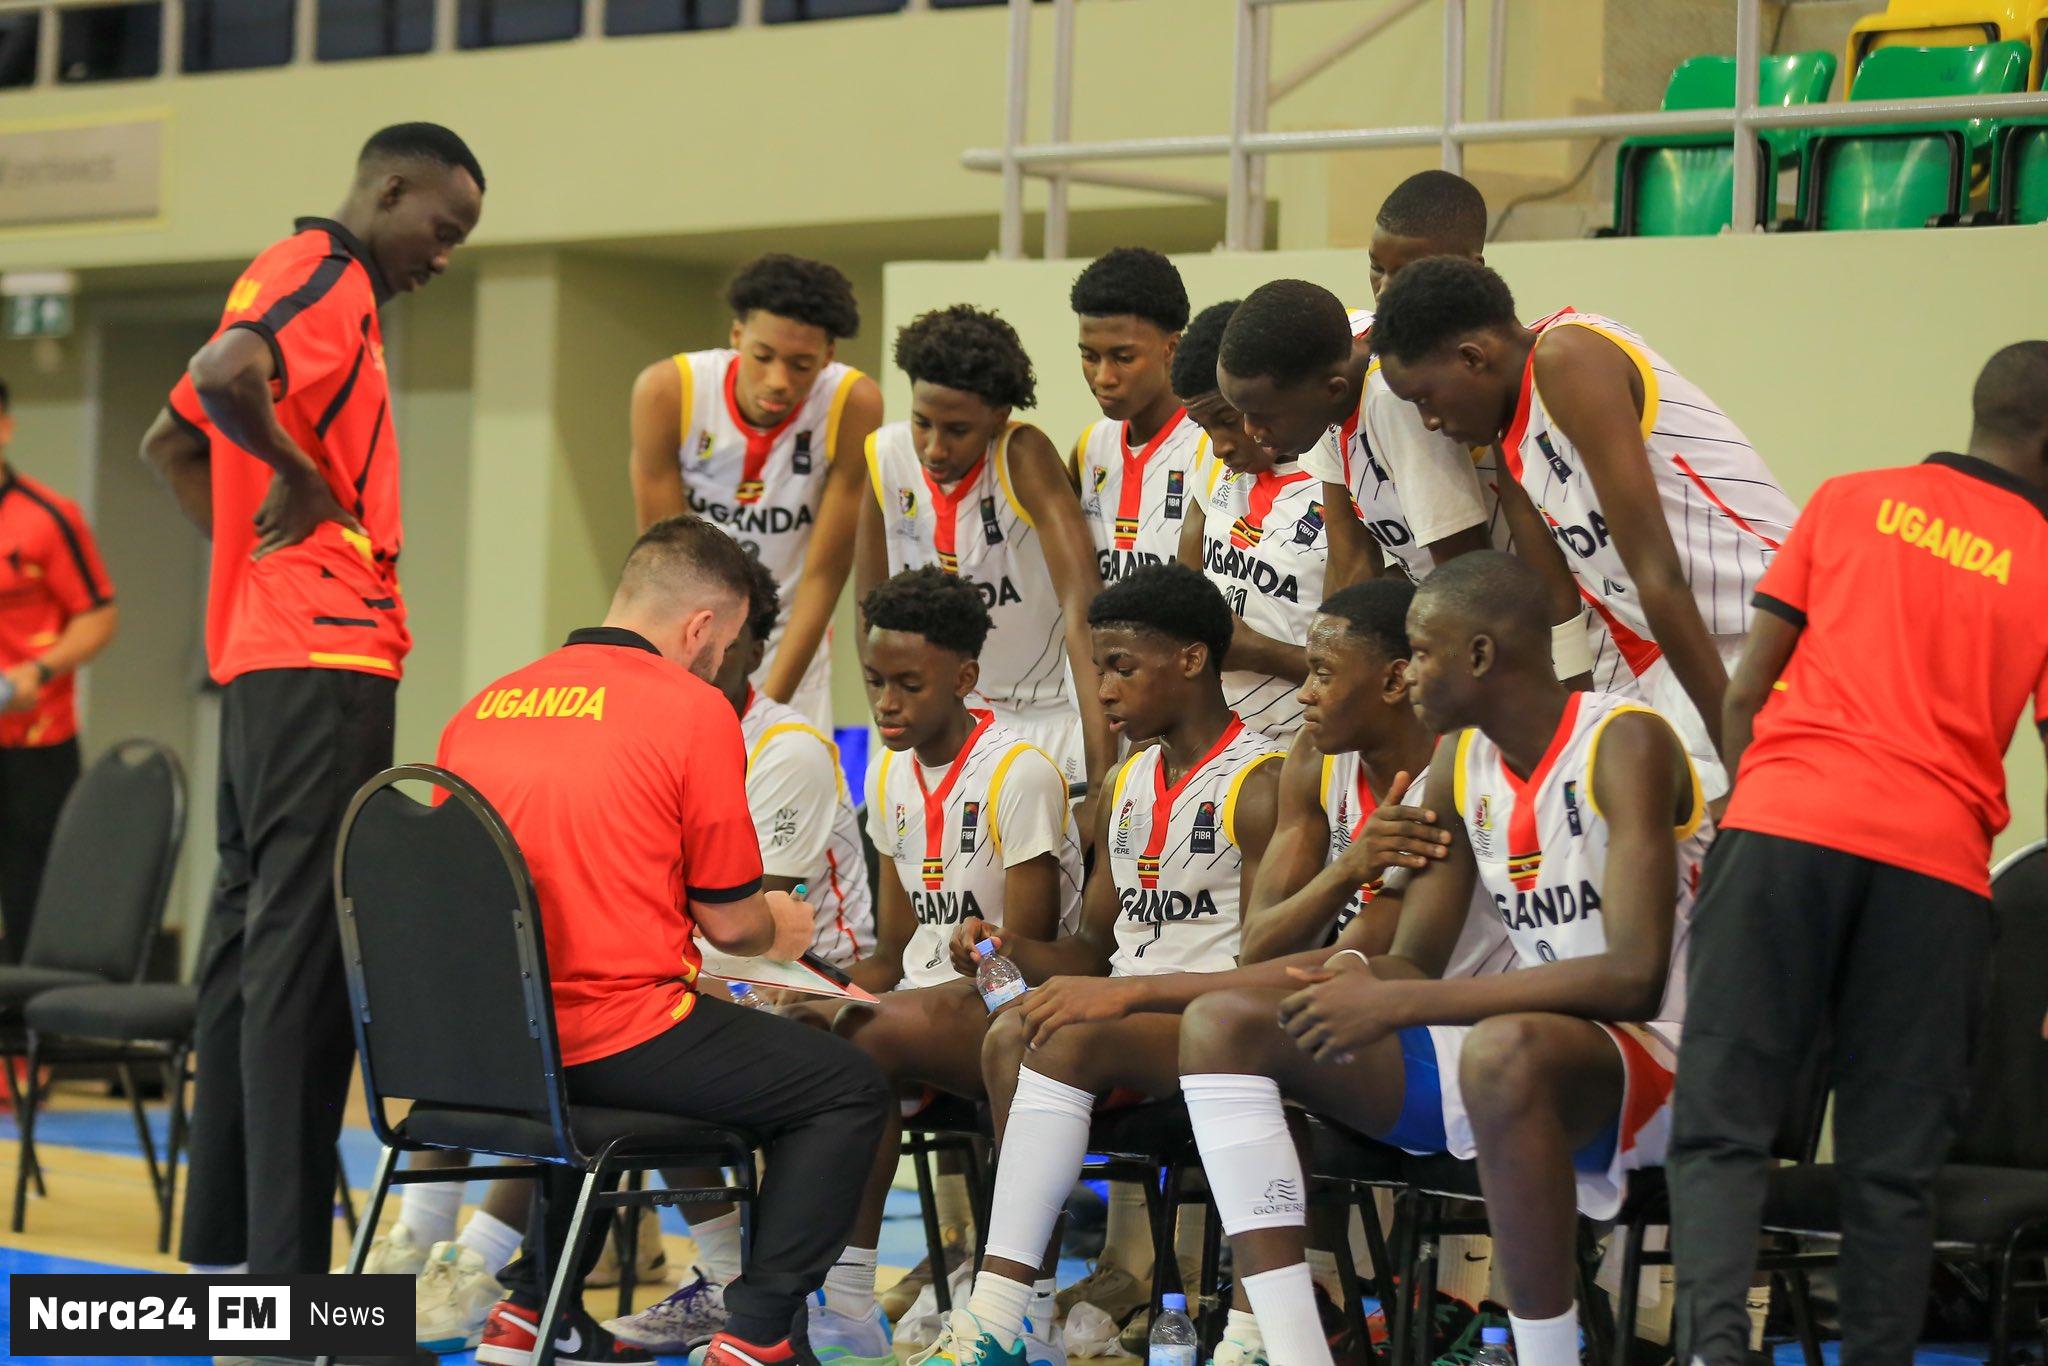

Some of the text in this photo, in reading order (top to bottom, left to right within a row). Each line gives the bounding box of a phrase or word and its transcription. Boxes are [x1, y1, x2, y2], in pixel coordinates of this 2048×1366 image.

[688, 488, 813, 534] UGANDA
[1299, 523, 1314, 538] FIBA
[1875, 499, 2012, 585] UGANDA
[475, 686, 606, 721] UGANDA
[1194, 830, 1211, 841] FIBA
[905, 890, 985, 926] GANDA
[1116, 886, 1219, 923] GANDA
[1134, 920, 1162, 958] 7
